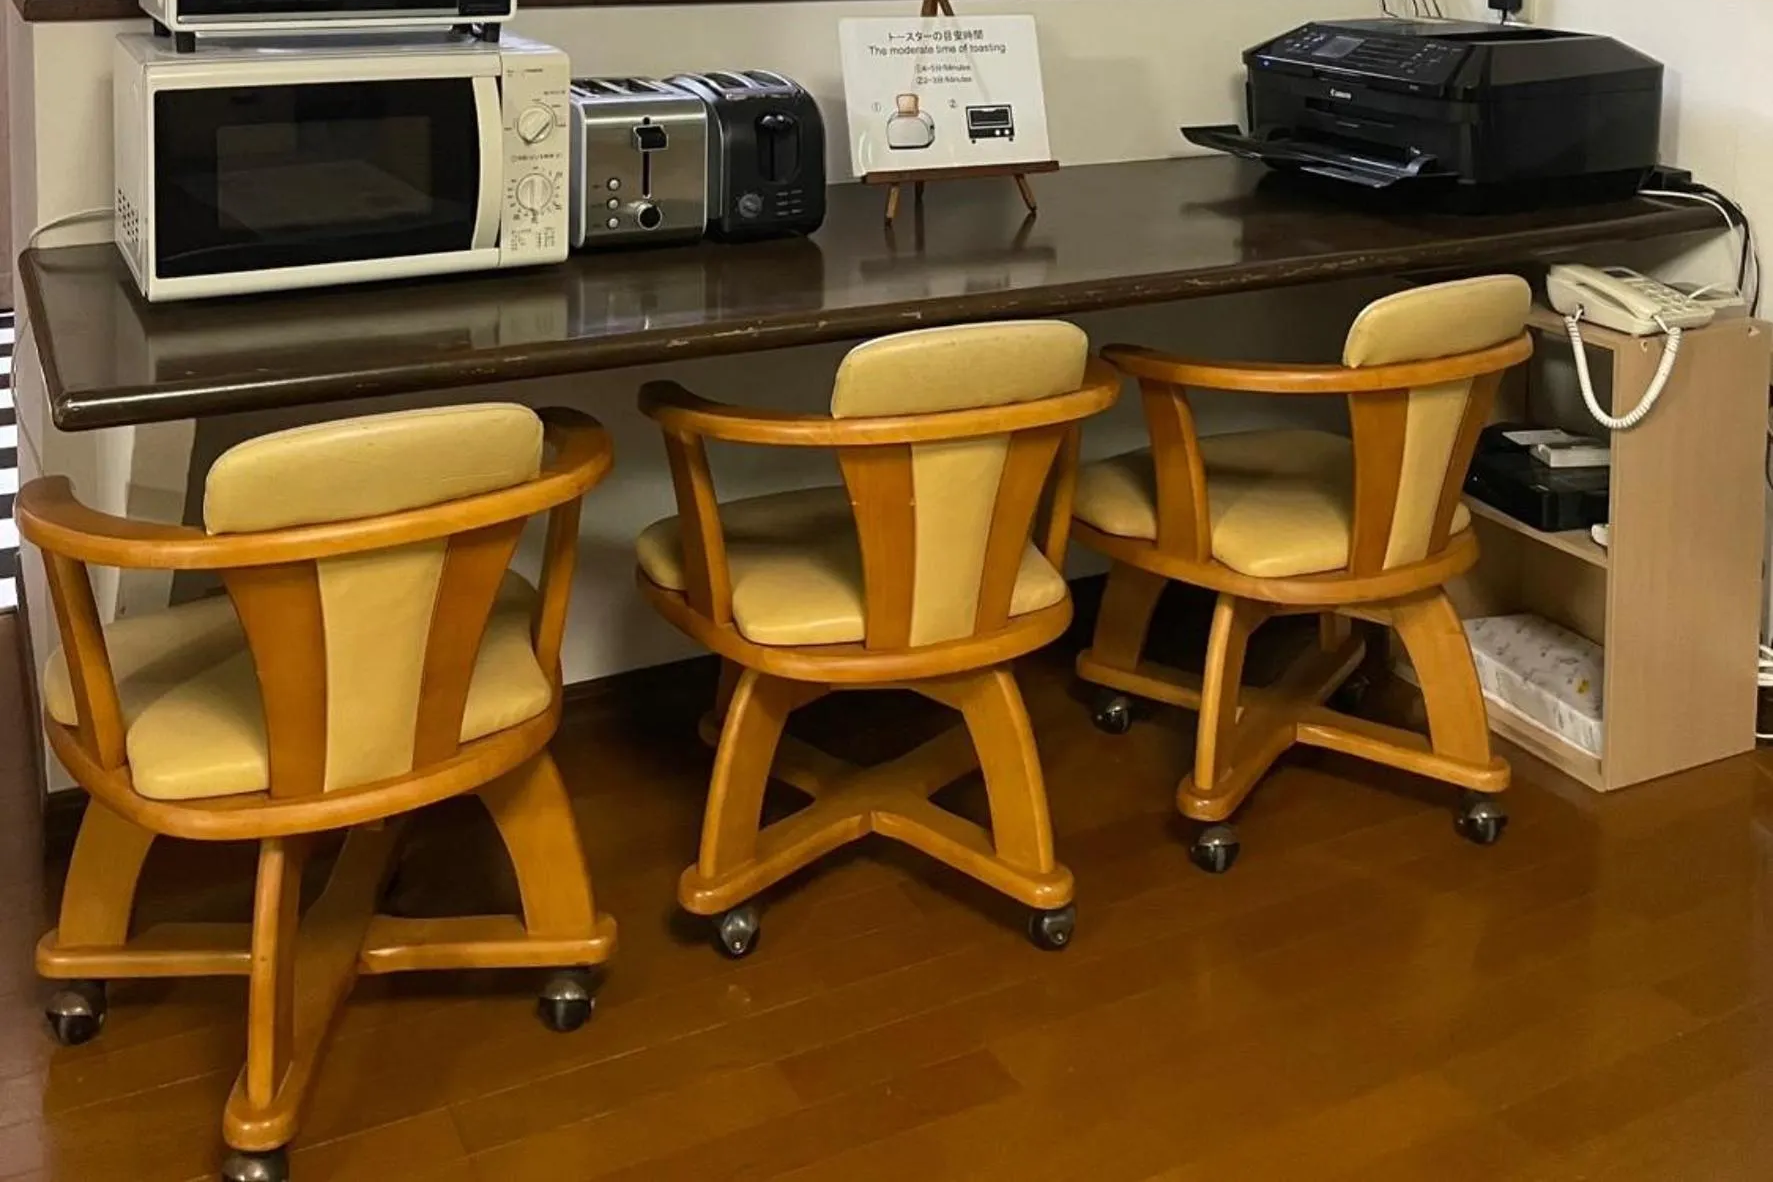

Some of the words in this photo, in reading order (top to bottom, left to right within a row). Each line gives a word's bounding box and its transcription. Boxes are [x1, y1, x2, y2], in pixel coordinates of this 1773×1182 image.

[869, 46, 888, 55] The
[890, 45, 934, 55] moderate
[936, 44, 957, 53] time
[959, 43, 968, 53] of
[970, 43, 1006, 54] toasting
